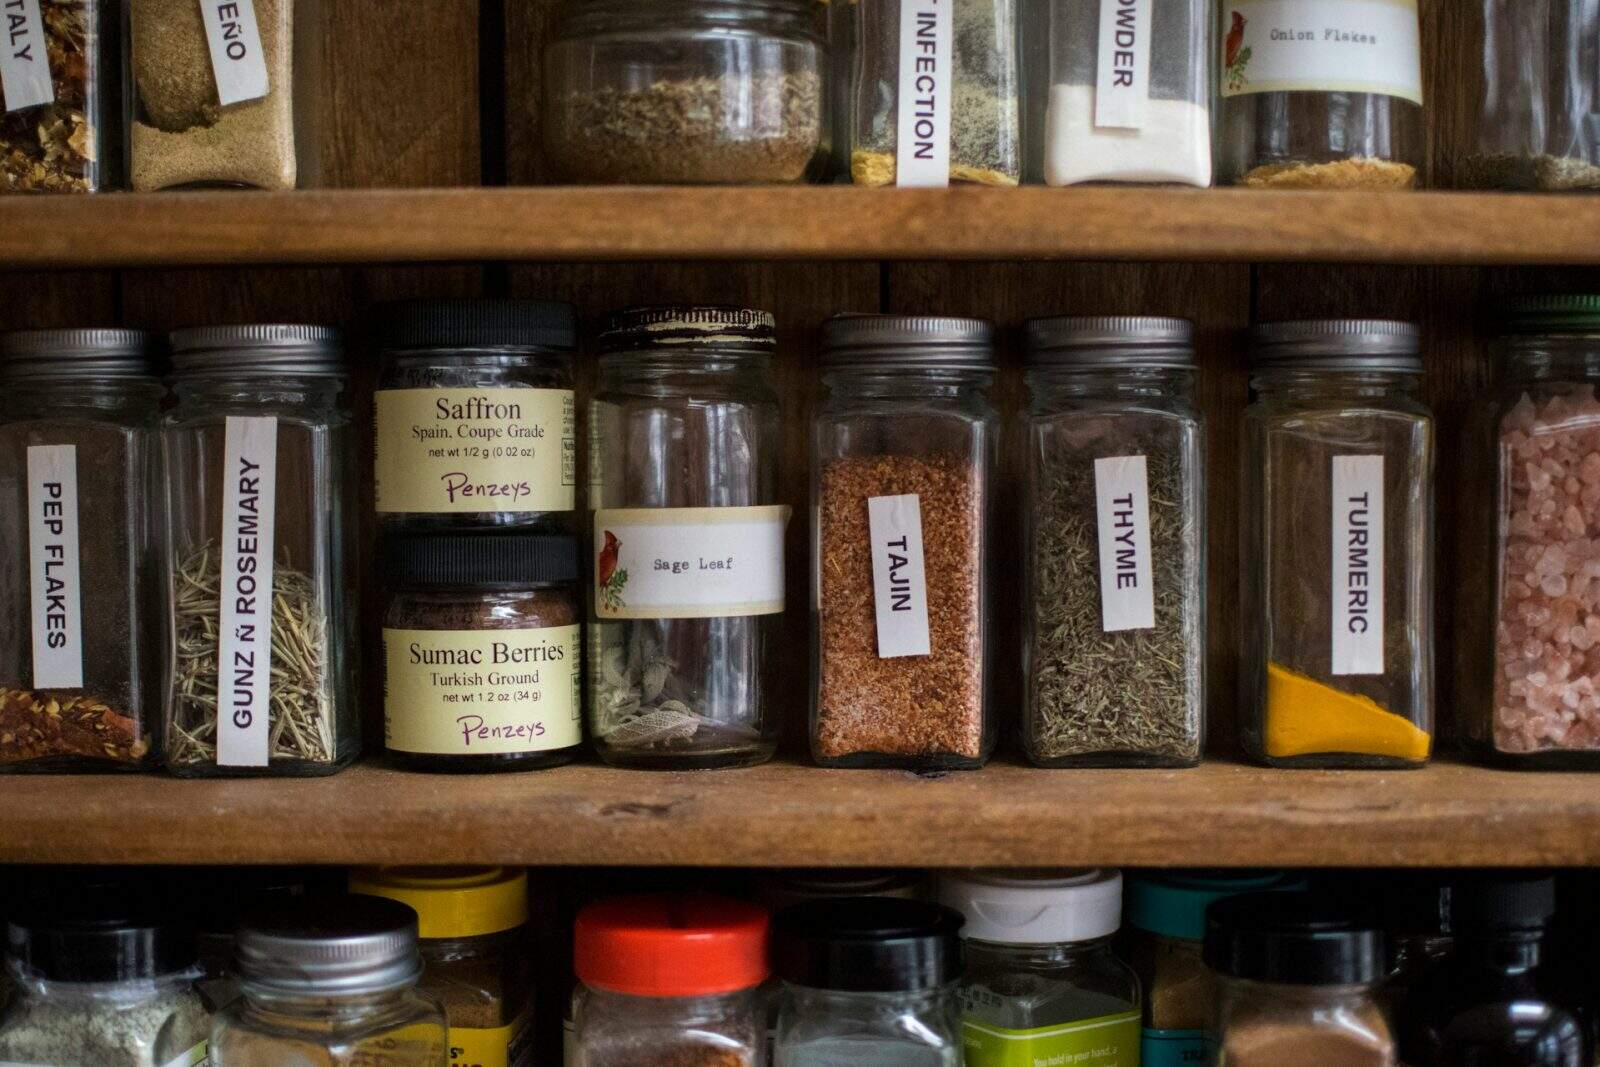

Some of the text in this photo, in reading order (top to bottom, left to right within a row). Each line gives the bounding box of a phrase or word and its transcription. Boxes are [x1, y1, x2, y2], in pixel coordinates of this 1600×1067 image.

[5, 0, 33, 62] TALY
[217, 0, 246, 61] EÑO
[1113, 0, 1135, 87] WDER
[1270, 28, 1377, 45] Onion Flakes
[914, 12, 936, 160] INFECTION
[436, 397, 521, 421] Saffron
[457, 424, 502, 442] Coupe
[507, 424, 545, 439] Grade
[428, 446, 536, 459] net wt 1/2 g (002 oz)
[440, 471, 531, 504] Penzeys
[1112, 493, 1138, 589] THYME
[43, 482, 66, 649] PEP FLAKES
[653, 557, 735, 574] Sage Leaf
[887, 535, 912, 612] TAJIN
[1347, 491, 1369, 634] TURMERIC
[232, 457, 260, 729] GUNZ Ñ ROSEMARY
[409, 642, 482, 665] Sumac
[491, 640, 564, 664] Berries
[429, 669, 539, 686] Turkish Ground
[442, 692, 459, 702] net
[461, 692, 474, 702] wt
[497, 692, 510, 702] oz
[513, 690, 529, 703] (34
[532, 689, 542, 702] g)
[456, 713, 546, 746] Penzeys
